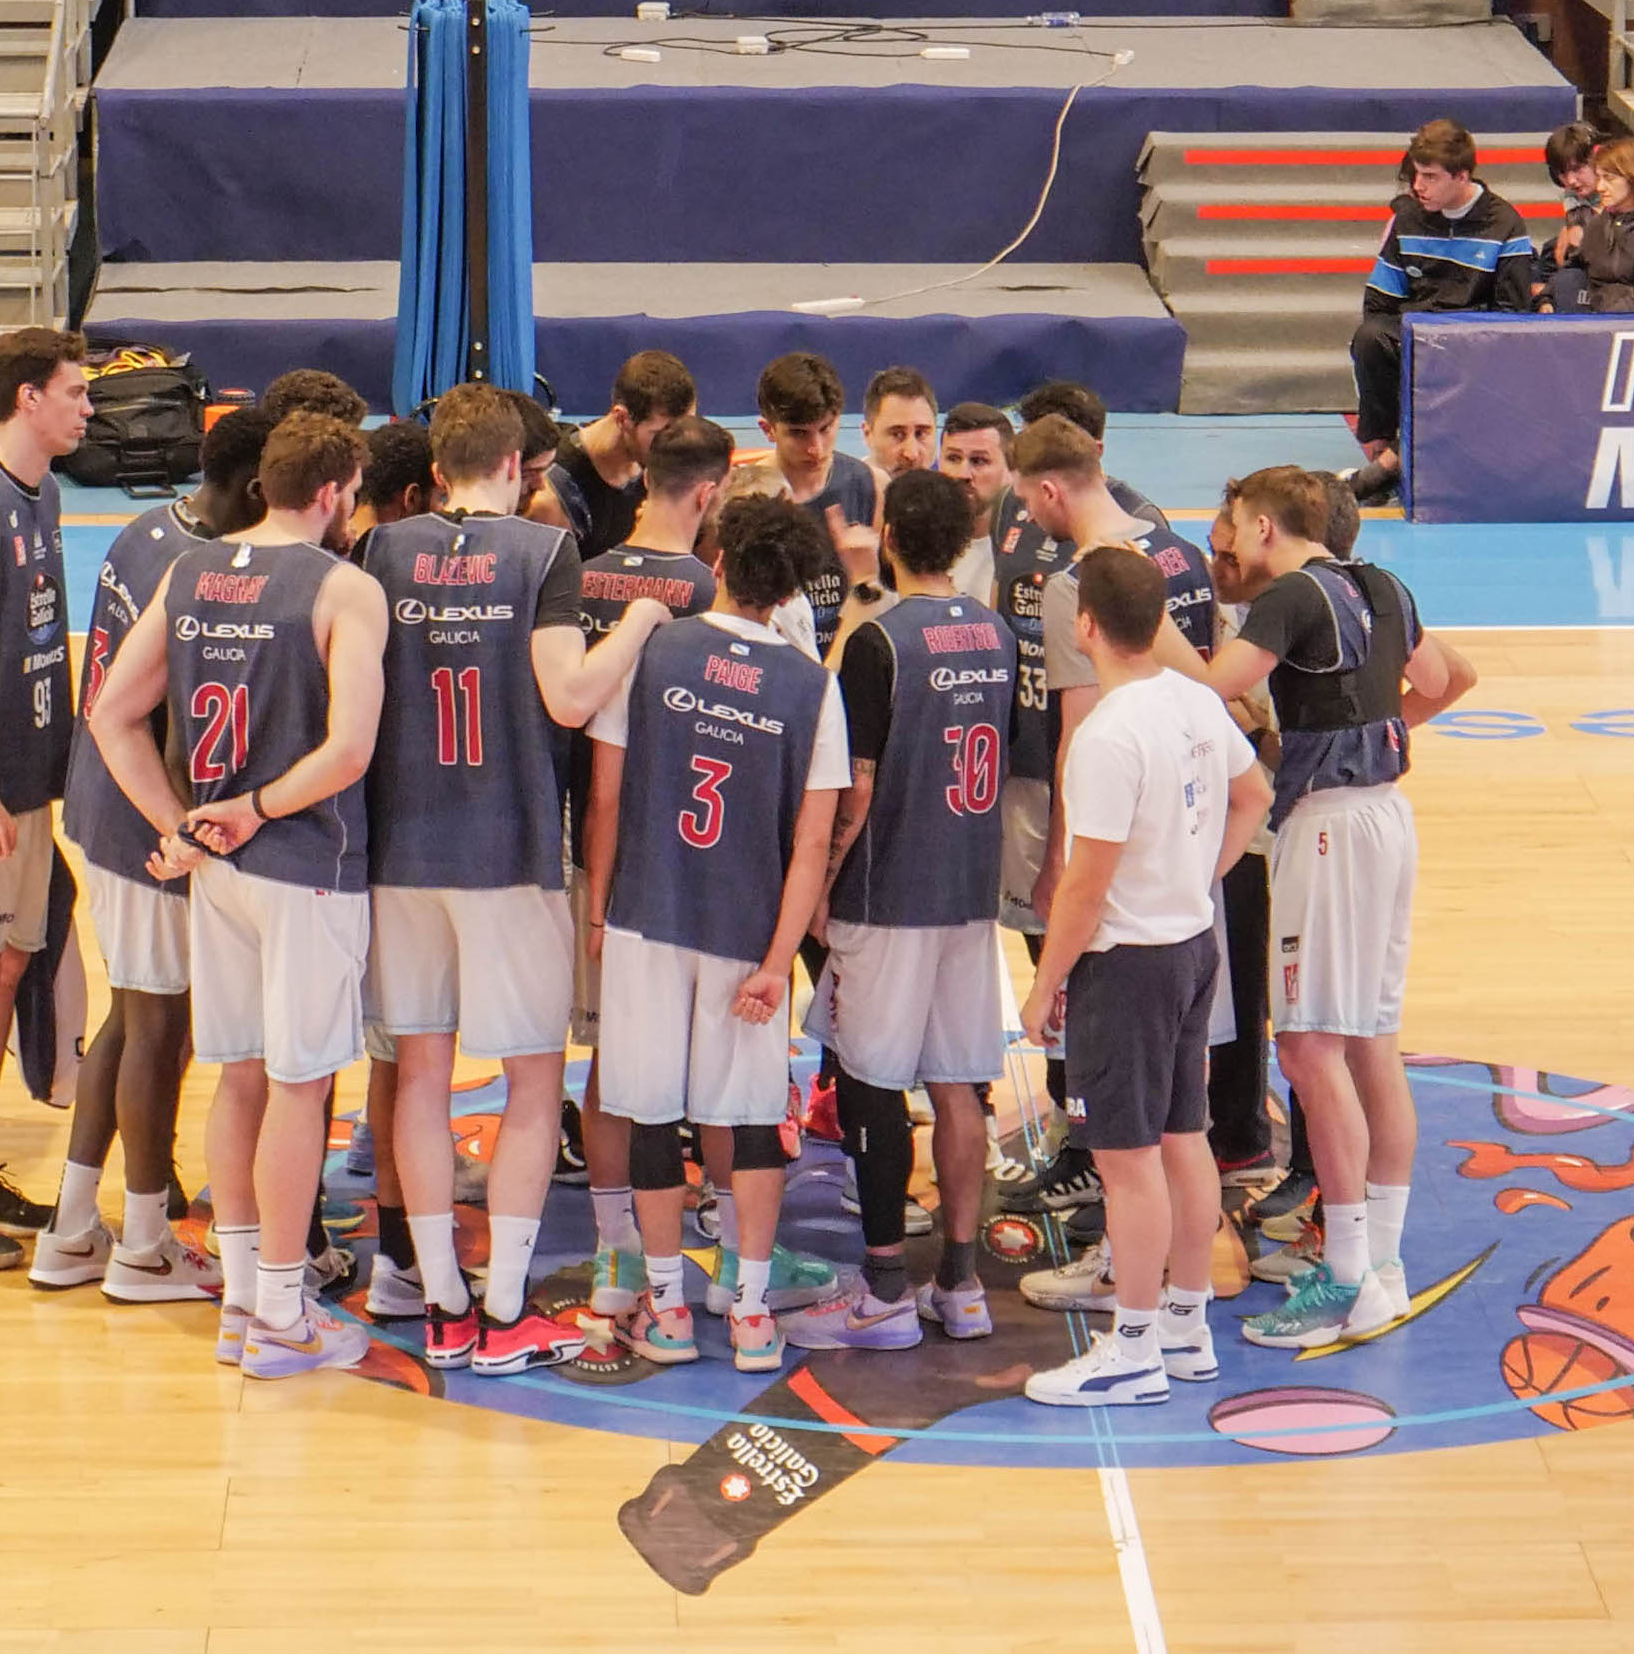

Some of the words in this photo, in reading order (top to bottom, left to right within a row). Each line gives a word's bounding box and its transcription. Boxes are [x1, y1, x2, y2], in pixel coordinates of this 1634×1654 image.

[582, 571, 695, 608] ESTERMANN
[1164, 587, 1213, 612] EXUS
[202, 621, 276, 641] LEXUS
[427, 605, 514, 622] LEXUS
[429, 630, 481, 646] GALICIA
[705, 654, 764, 696] PAIGE
[951, 667, 1009, 686] LEXUS
[1019, 664, 1048, 712] 33
[190, 681, 249, 783] 21
[431, 666, 484, 766] 11
[695, 721, 745, 748] GALICIA
[698, 697, 784, 737] LEXUS
[943, 722, 1001, 817] 30
[677, 754, 734, 851] 3
[1318, 831, 1328, 857] 5
[726, 1431, 806, 1507] Estrella
[748, 1422, 823, 1489] Galicia
